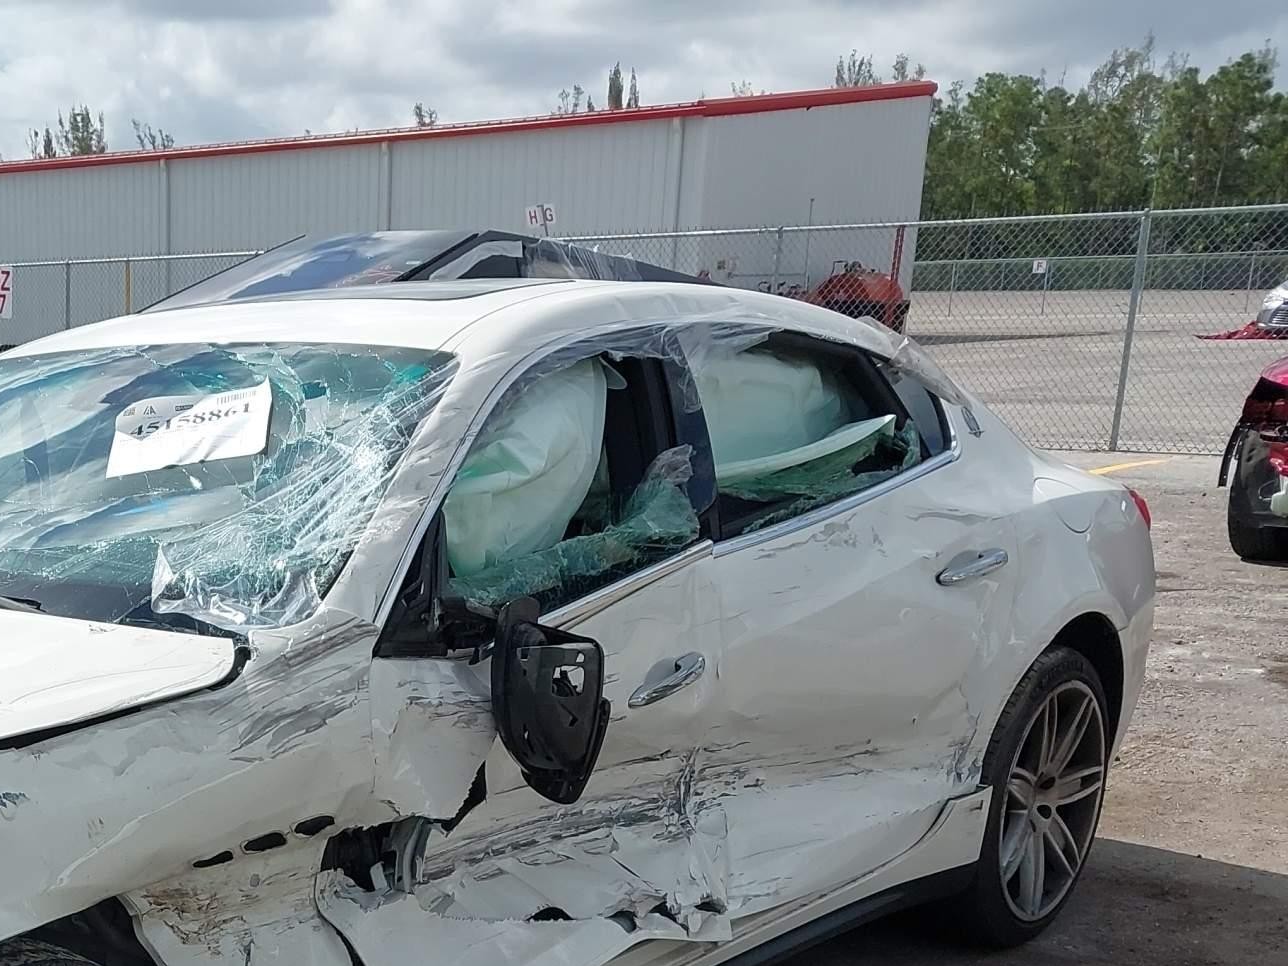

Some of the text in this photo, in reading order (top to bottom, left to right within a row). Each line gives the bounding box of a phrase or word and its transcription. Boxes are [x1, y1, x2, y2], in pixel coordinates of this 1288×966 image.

[528, 207, 554, 225] H G
[129, 402, 252, 437] 45158861
